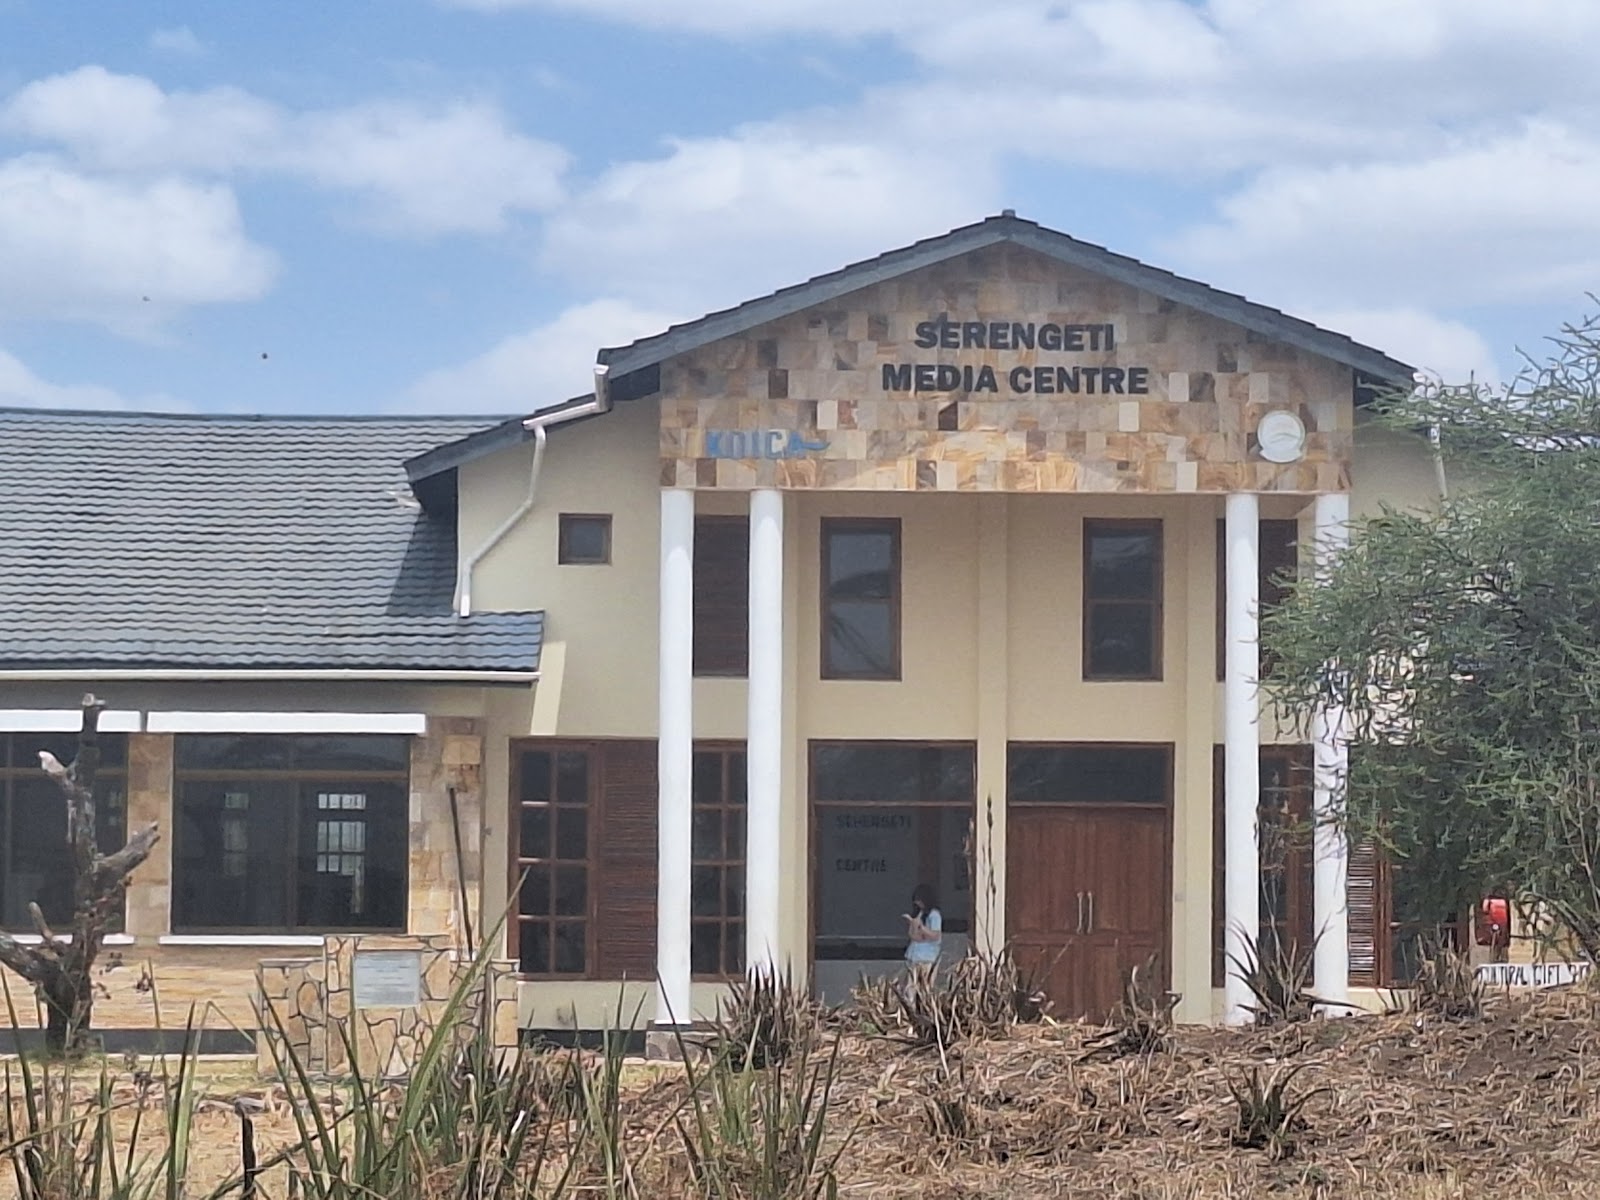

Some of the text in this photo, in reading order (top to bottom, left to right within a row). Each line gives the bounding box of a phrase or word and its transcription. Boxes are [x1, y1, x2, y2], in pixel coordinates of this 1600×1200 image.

[914, 321, 1114, 351] SERENGETI
[882, 364, 1149, 394] MEDIA CENTRE
